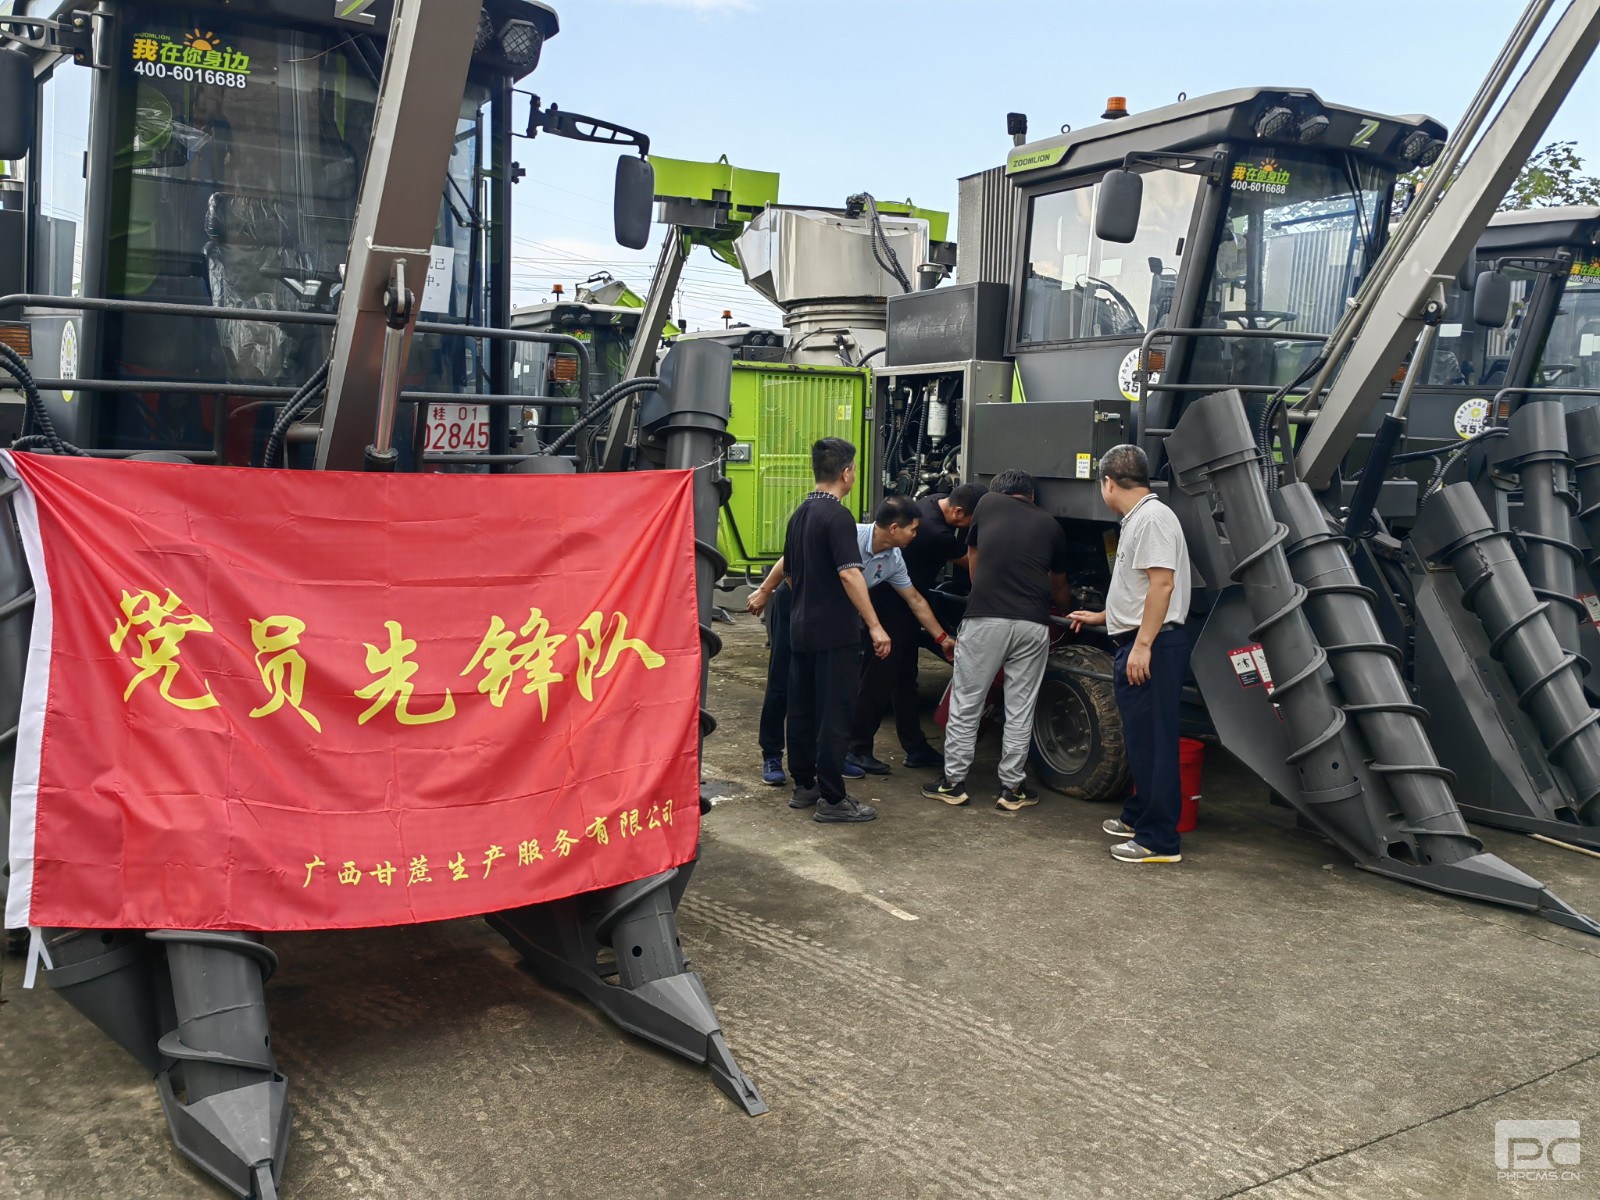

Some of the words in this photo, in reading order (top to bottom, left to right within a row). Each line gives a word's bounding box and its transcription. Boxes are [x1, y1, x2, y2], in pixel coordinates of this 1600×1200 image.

[132, 38, 250, 71] 我在你身边
[133, 60, 247, 89] 400-6016688
[1013, 153, 1051, 168] ZOOMLION
[1231, 165, 1290, 184] 我在你身边
[1230, 180, 1286, 195] 400-6016688
[433, 406, 446, 421] 桂
[458, 406, 478, 421] 01
[109, 587, 666, 733] 党员先锋队
[302, 799, 674, 888] 广西甘蔗生产服务有限公司
